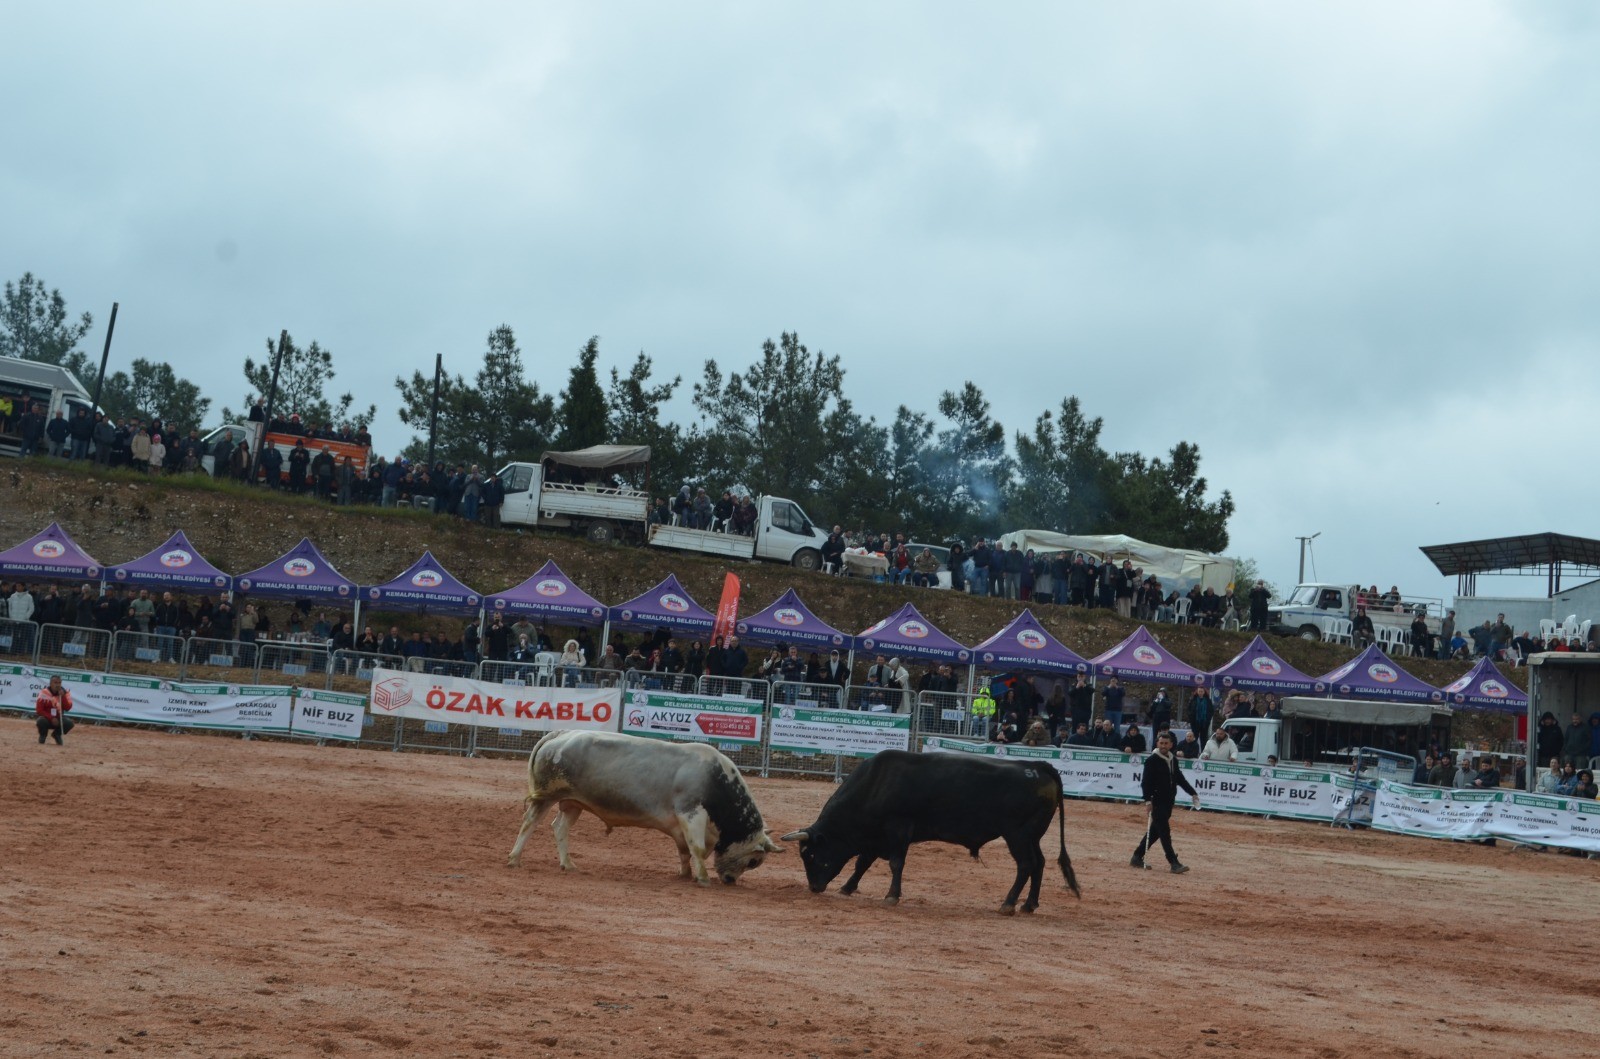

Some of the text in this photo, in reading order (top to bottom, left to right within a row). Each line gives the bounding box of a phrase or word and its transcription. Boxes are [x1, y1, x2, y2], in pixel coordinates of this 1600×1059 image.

[3, 563, 82, 574] KEMALPAŞA BELEDİYESİ
[132, 572, 210, 583] KEMALPAŞA BELEDİYESİ
[256, 582, 333, 592] KEMALPAŞA BELEDİYESİ
[386, 590, 462, 602] KEMALPAŞA BELEDİYESİ
[511, 602, 587, 614] KEMALPAŞA BELEDİYESİ
[637, 613, 713, 626] KEMALPAŞA BELEDİYESİ
[752, 627, 829, 641] KEMALPAŞA BELEDİYESİ
[880, 642, 955, 656] KEMALPAŞA BELEDİYESİ
[999, 656, 1072, 669] KEMALPAŞA BELEDİYESİ
[1118, 669, 1191, 681] KEMALPAŞA BELEDİYESİ
[1238, 679, 1311, 690] KEMALPAŞA BELEDİYESİ
[1355, 687, 1428, 699] KEMALPAŞA BELEDİYESİ
[168, 698, 187, 706] İZMİR
[426, 686, 612, 722] ÖZAK KABLO
[664, 701, 704, 710] GELENEKSEL
[1469, 697, 1505, 705] KEMALPAŞA
[239, 709, 272, 717] BESİCİLİK
[303, 706, 324, 718] NİF
[328, 711, 355, 722] BUZ
[651, 711, 692, 723] AKYÜZ
[811, 715, 851, 724] GELENEKSEL
[871, 720, 895, 728] GÜREŞİ
[1195, 778, 1247, 793] NİF BUZ
[1264, 785, 1317, 800] NİF BUZ
[1570, 824, 1589, 833] İHSAN
